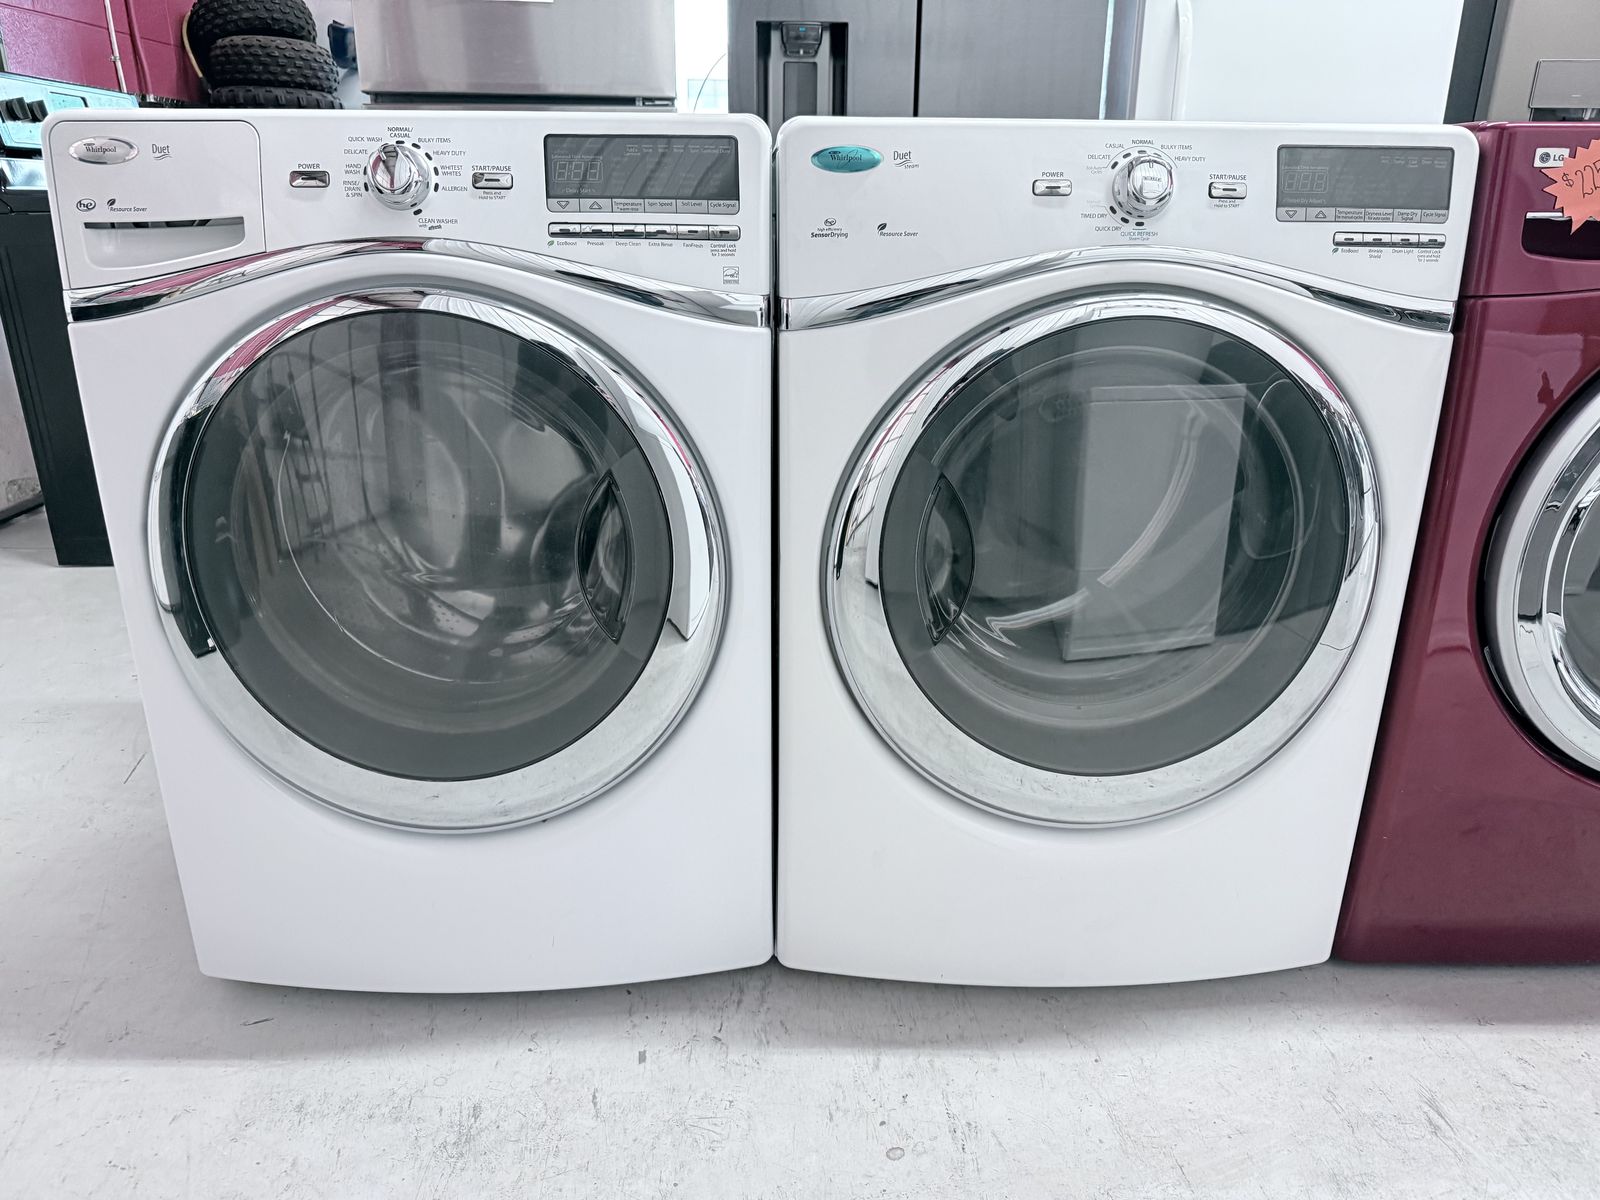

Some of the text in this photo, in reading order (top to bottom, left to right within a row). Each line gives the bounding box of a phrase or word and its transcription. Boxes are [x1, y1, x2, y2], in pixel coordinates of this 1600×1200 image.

[85, 145, 117, 155] Whirlpool
[152, 143, 170, 154] Duet
[830, 154, 862, 163] Whirlpool
[893, 150, 912, 161] Duet
